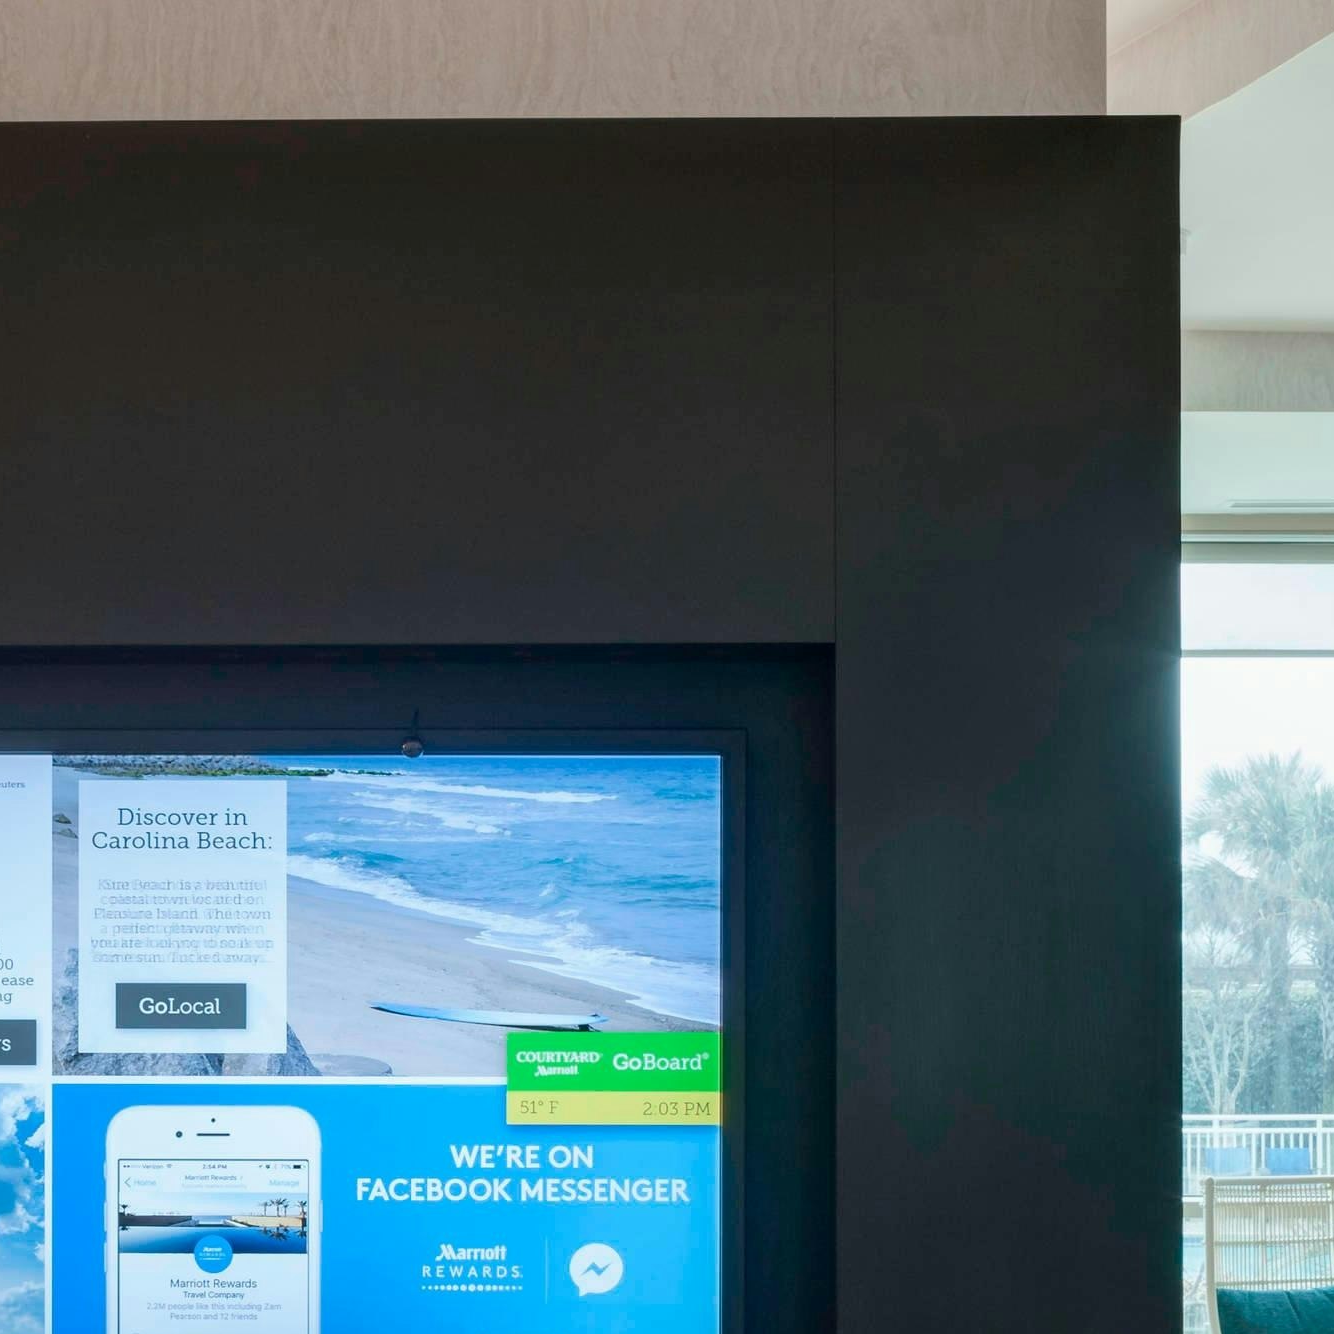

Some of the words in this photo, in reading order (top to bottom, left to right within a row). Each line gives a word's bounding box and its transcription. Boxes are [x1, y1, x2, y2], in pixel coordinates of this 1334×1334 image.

[118, 808, 218, 826] Discover
[225, 808, 248, 826] in
[92, 832, 190, 849] Carolina
[196, 832, 272, 849] Beach:
[2, 974, 34, 988] ease
[139, 998, 221, 1014] GoLocal
[550, 1100, 559, 1114] F
[642, 1102, 678, 1116] 2:03
[684, 1102, 712, 1116] PM
[548, 1144, 593, 1168] ON
[356, 1178, 513, 1201] FACEBOOK
[520, 1178, 690, 1201] MESSENGER
[435, 1244, 507, 1261] Marriott
[170, 1279, 210, 1288] Marriott
[214, 1279, 258, 1288] Rewards
[208, 1291, 244, 1300] Company
[168, 1302, 194, 1311] people
